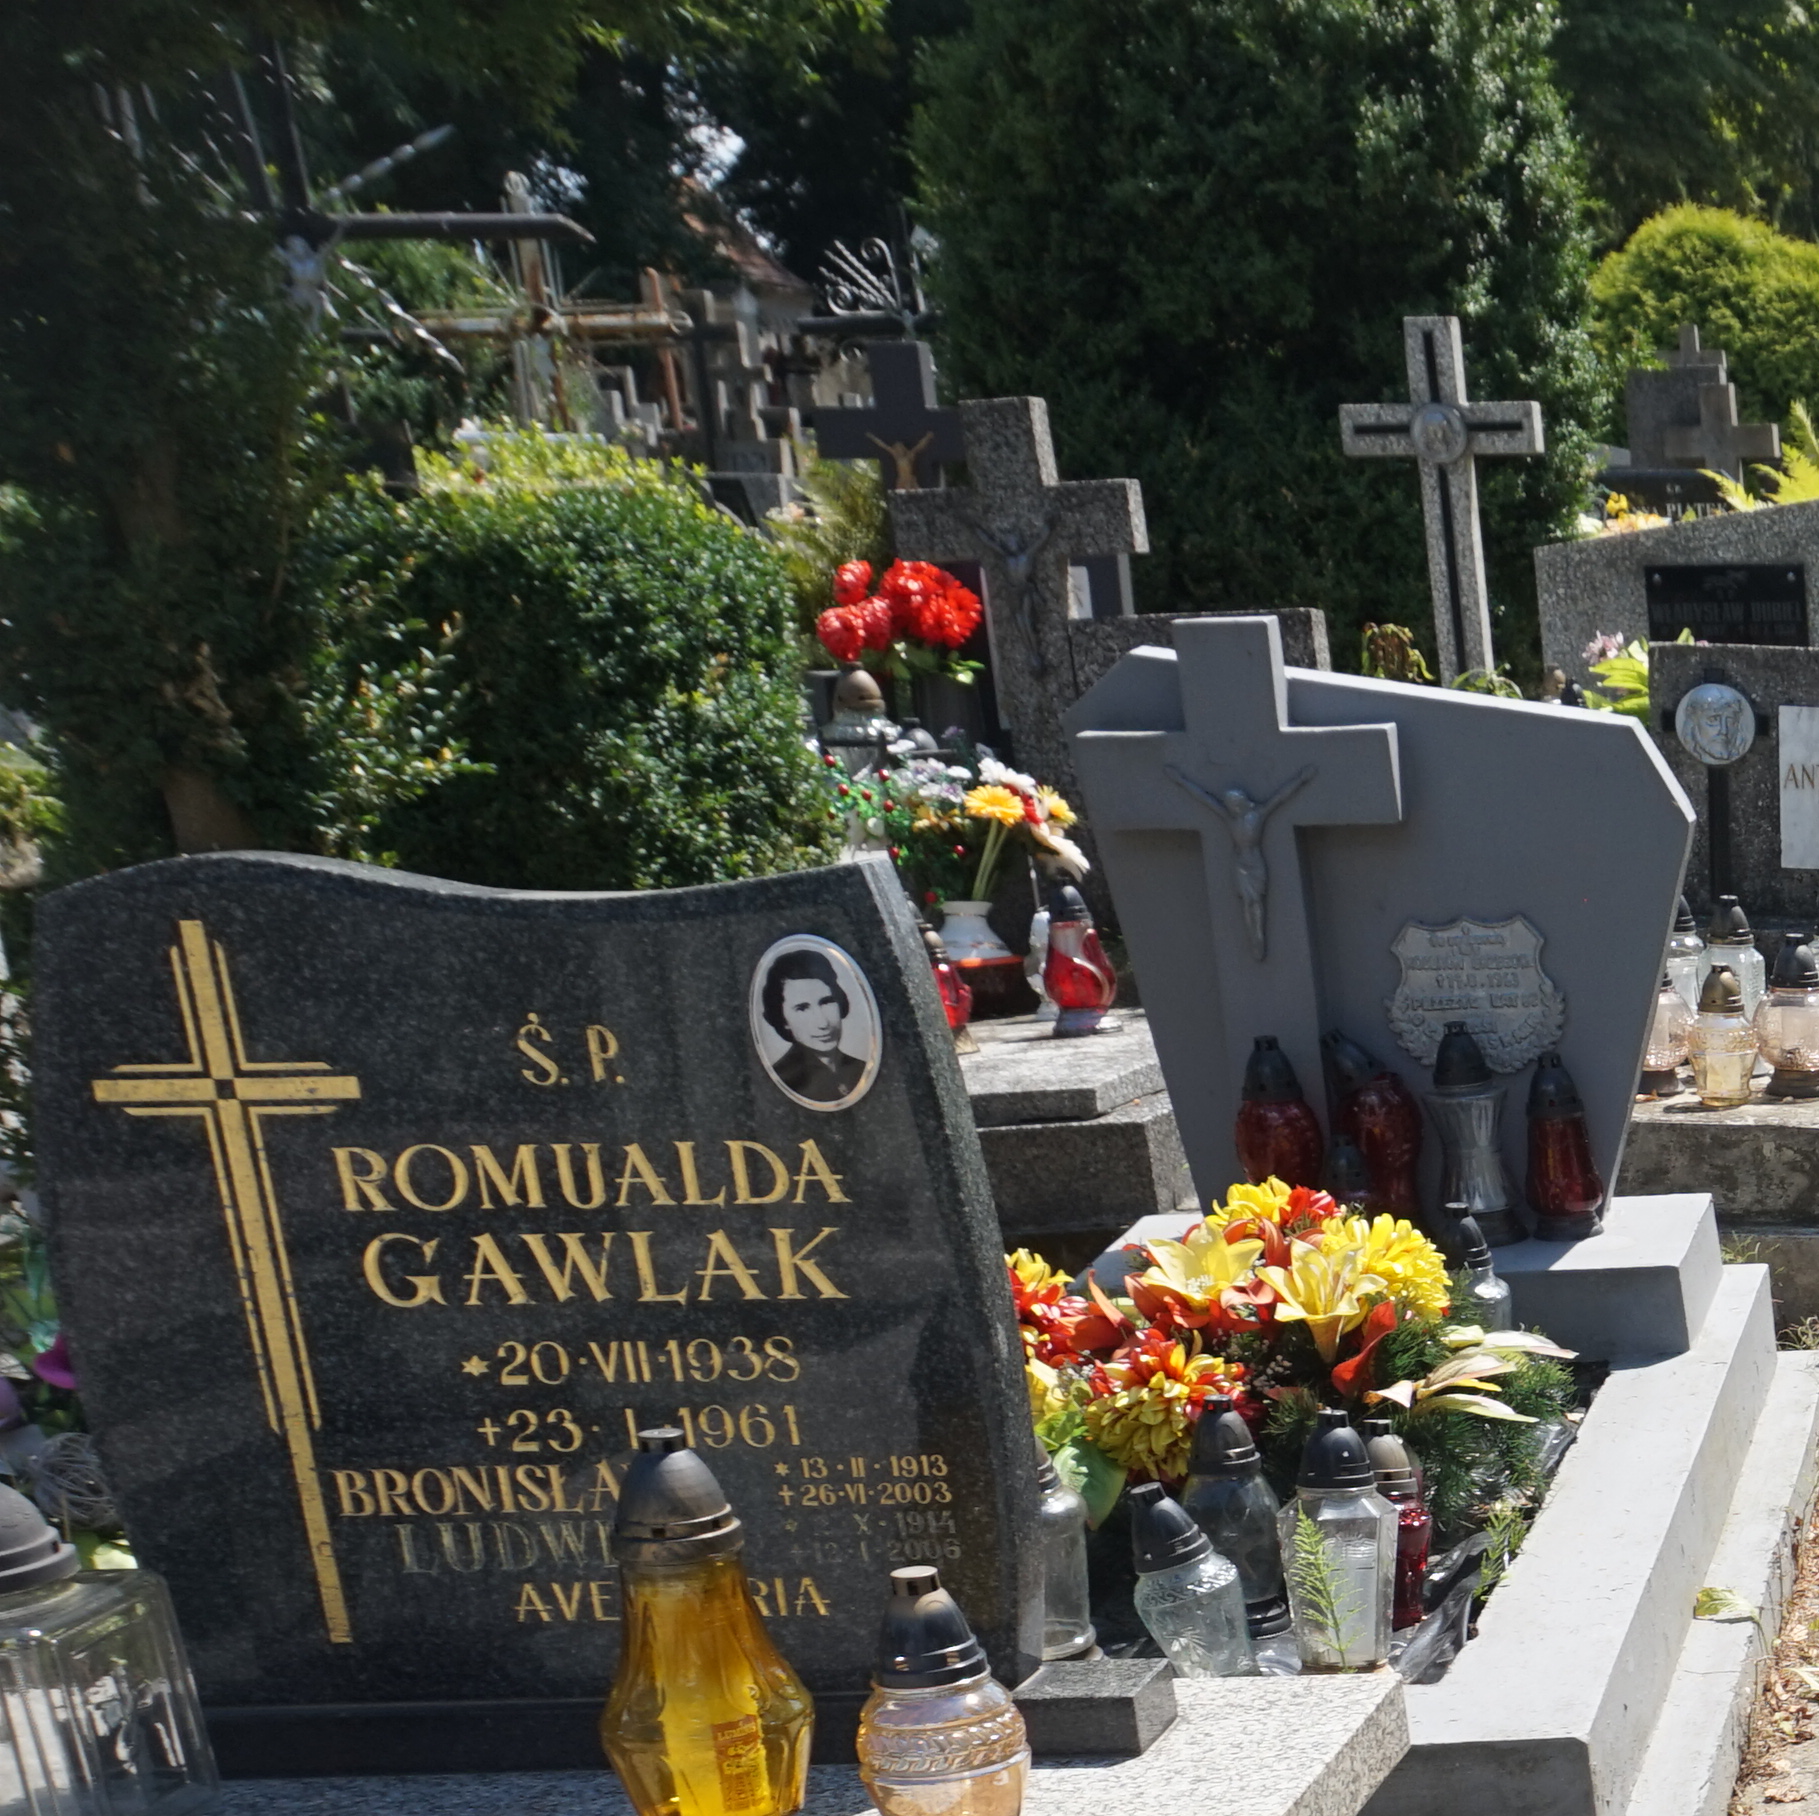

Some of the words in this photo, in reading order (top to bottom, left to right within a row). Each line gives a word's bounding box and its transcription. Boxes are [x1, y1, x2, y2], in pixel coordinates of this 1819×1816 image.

[515, 1011, 571, 1087] Ś.
[585, 1023, 626, 1085] P.
[329, 1137, 854, 1213] ROMUALDA
[361, 1226, 853, 1309] GAWLAK
[328, 1457, 632, 1517] BRONISŁA
[392, 1520, 622, 1576] LUDWI
[514, 1580, 622, 1622] AVE
[746, 1576, 832, 1618] RIA
